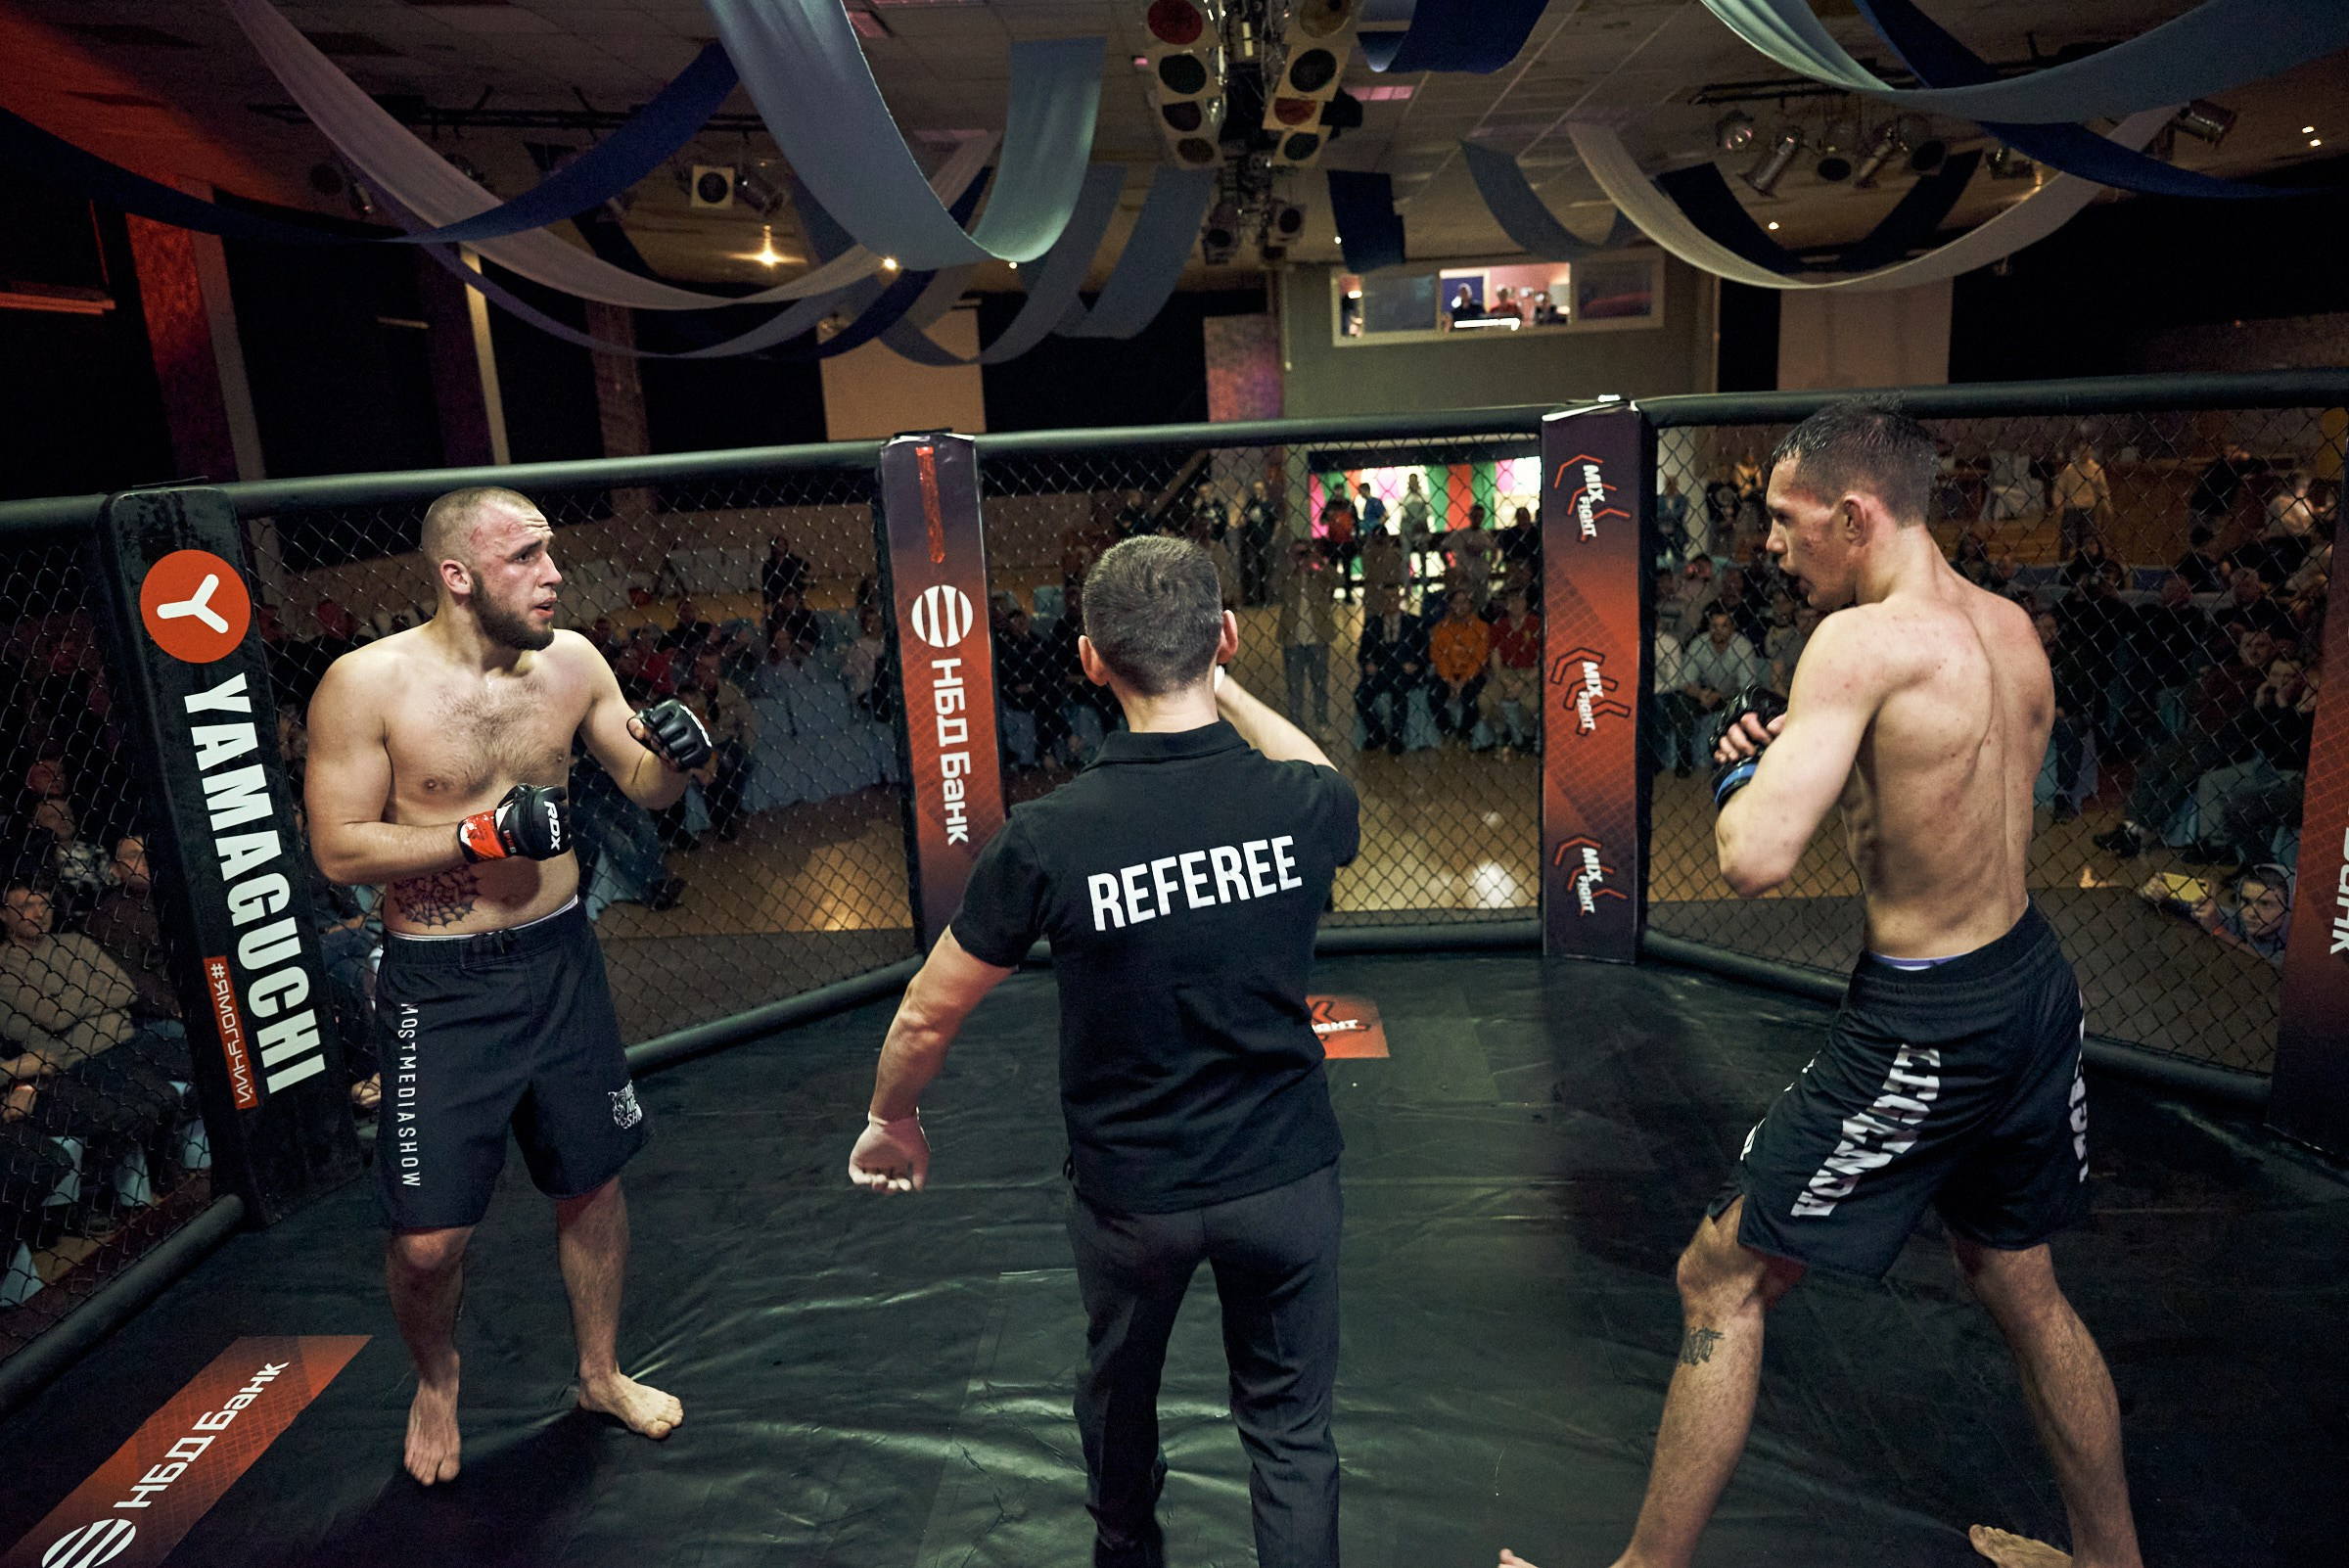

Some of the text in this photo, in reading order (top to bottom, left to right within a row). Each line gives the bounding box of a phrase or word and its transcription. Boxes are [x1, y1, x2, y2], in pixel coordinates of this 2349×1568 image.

[1583, 464, 1606, 503] MIX
[1577, 495, 1597, 537] FIGHT
[1582, 661, 1605, 698] MIX
[1577, 691, 1596, 731] FIGHT
[931, 658, 972, 846] НБД Банк
[543, 801, 561, 852] RDX
[184, 672, 326, 1095] YAMAGUCHI
[1087, 835, 1303, 932] REFEREE
[1582, 848, 1603, 883] MIX
[1577, 875, 1595, 913] FIGHT
[209, 963, 254, 1104] #ЯМОГУЧИЙ
[397, 1003, 421, 1186] MOSTMEDIASHOW
[113, 1361, 290, 1508] НБД Банк
